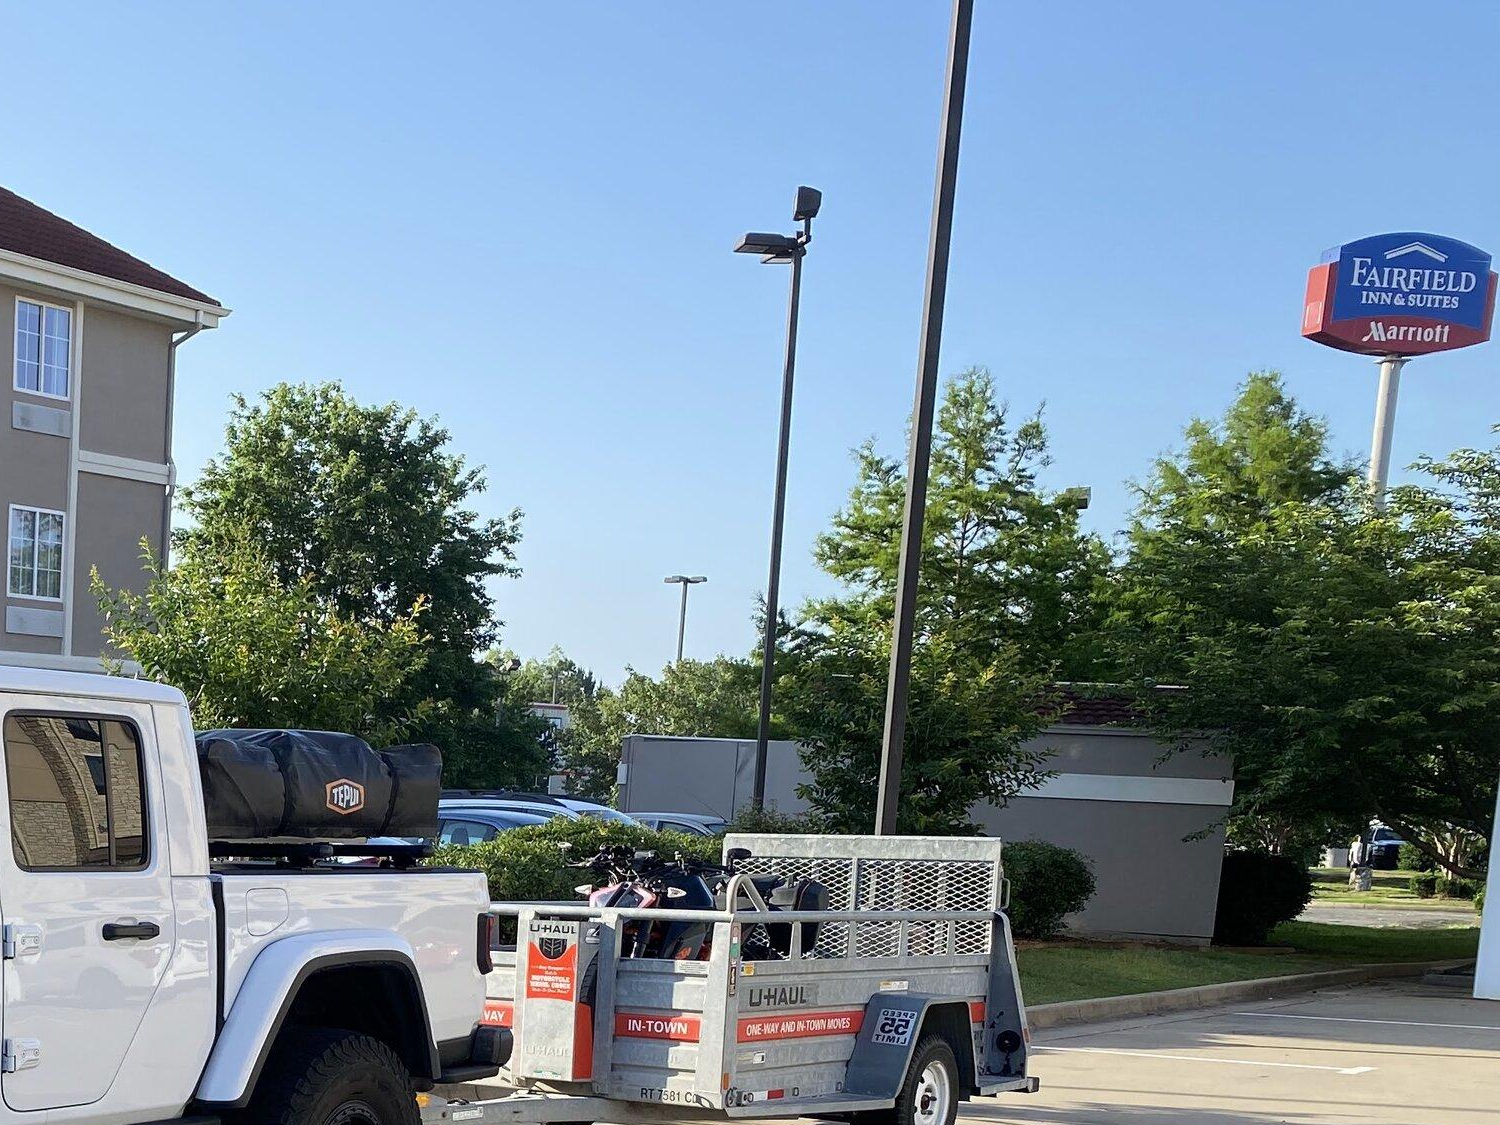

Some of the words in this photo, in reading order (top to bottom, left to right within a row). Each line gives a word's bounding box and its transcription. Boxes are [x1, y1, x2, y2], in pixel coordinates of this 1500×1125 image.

[1350, 257, 1477, 293] FAIRFIELD
[1360, 290, 1392, 306] INN
[1407, 293, 1460, 309] SUITES
[1361, 320, 1451, 343] Marriott
[332, 784, 360, 809] TEPUI
[529, 923, 577, 934] U-HAUL
[748, 986, 808, 1007] U-HAUL
[628, 1018, 688, 1035] IN-TOWN
[746, 1022, 780, 1037] ONE-WAY
[780, 1021, 796, 1034] AND
[796, 1019, 827, 1032] IN-TOWN
[827, 1017, 851, 1030] MOVES
[640, 1087, 655, 1099] RT
[656, 1089, 681, 1102] 7581
